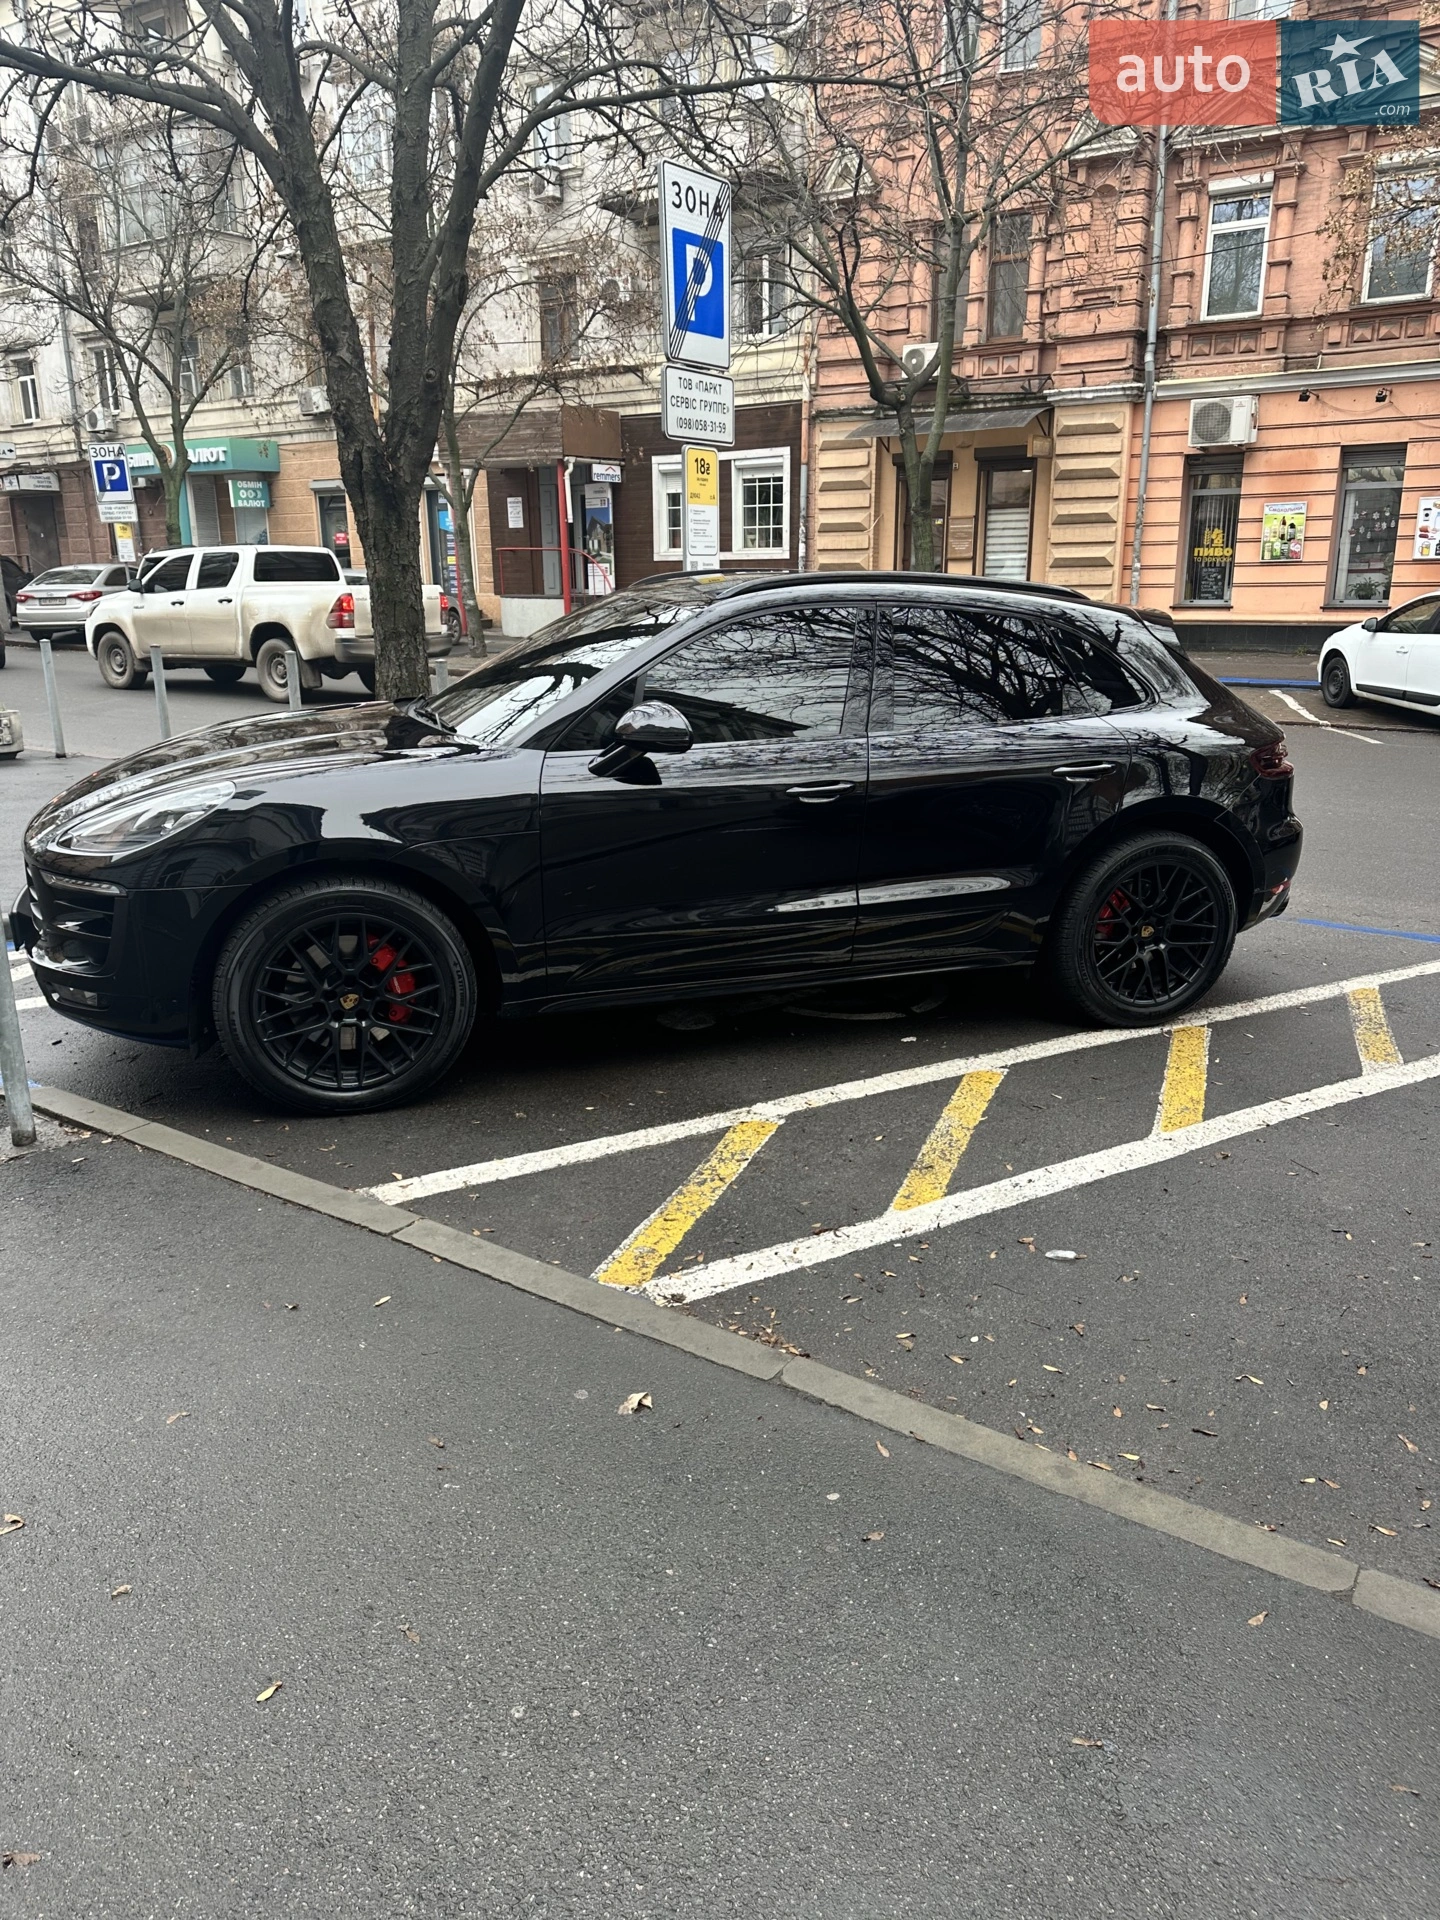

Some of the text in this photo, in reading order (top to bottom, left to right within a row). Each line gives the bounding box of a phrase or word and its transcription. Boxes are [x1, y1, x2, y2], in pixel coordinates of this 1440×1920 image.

[671, 181, 724, 222] ЗОНА
[678, 376, 722, 395] ТОВ «ПАРКТ
[670, 395, 697, 410] СЕРВІС
[90, 446, 125, 458] ЗОНА
[187, 446, 227, 463] АЛЮТ
[593, 472, 621, 481] remmers
[236, 480, 263, 489] ОБМІН
[237, 499, 266, 507] ВАЛЮТ
[1193, 547, 1233, 557] ПИВО
